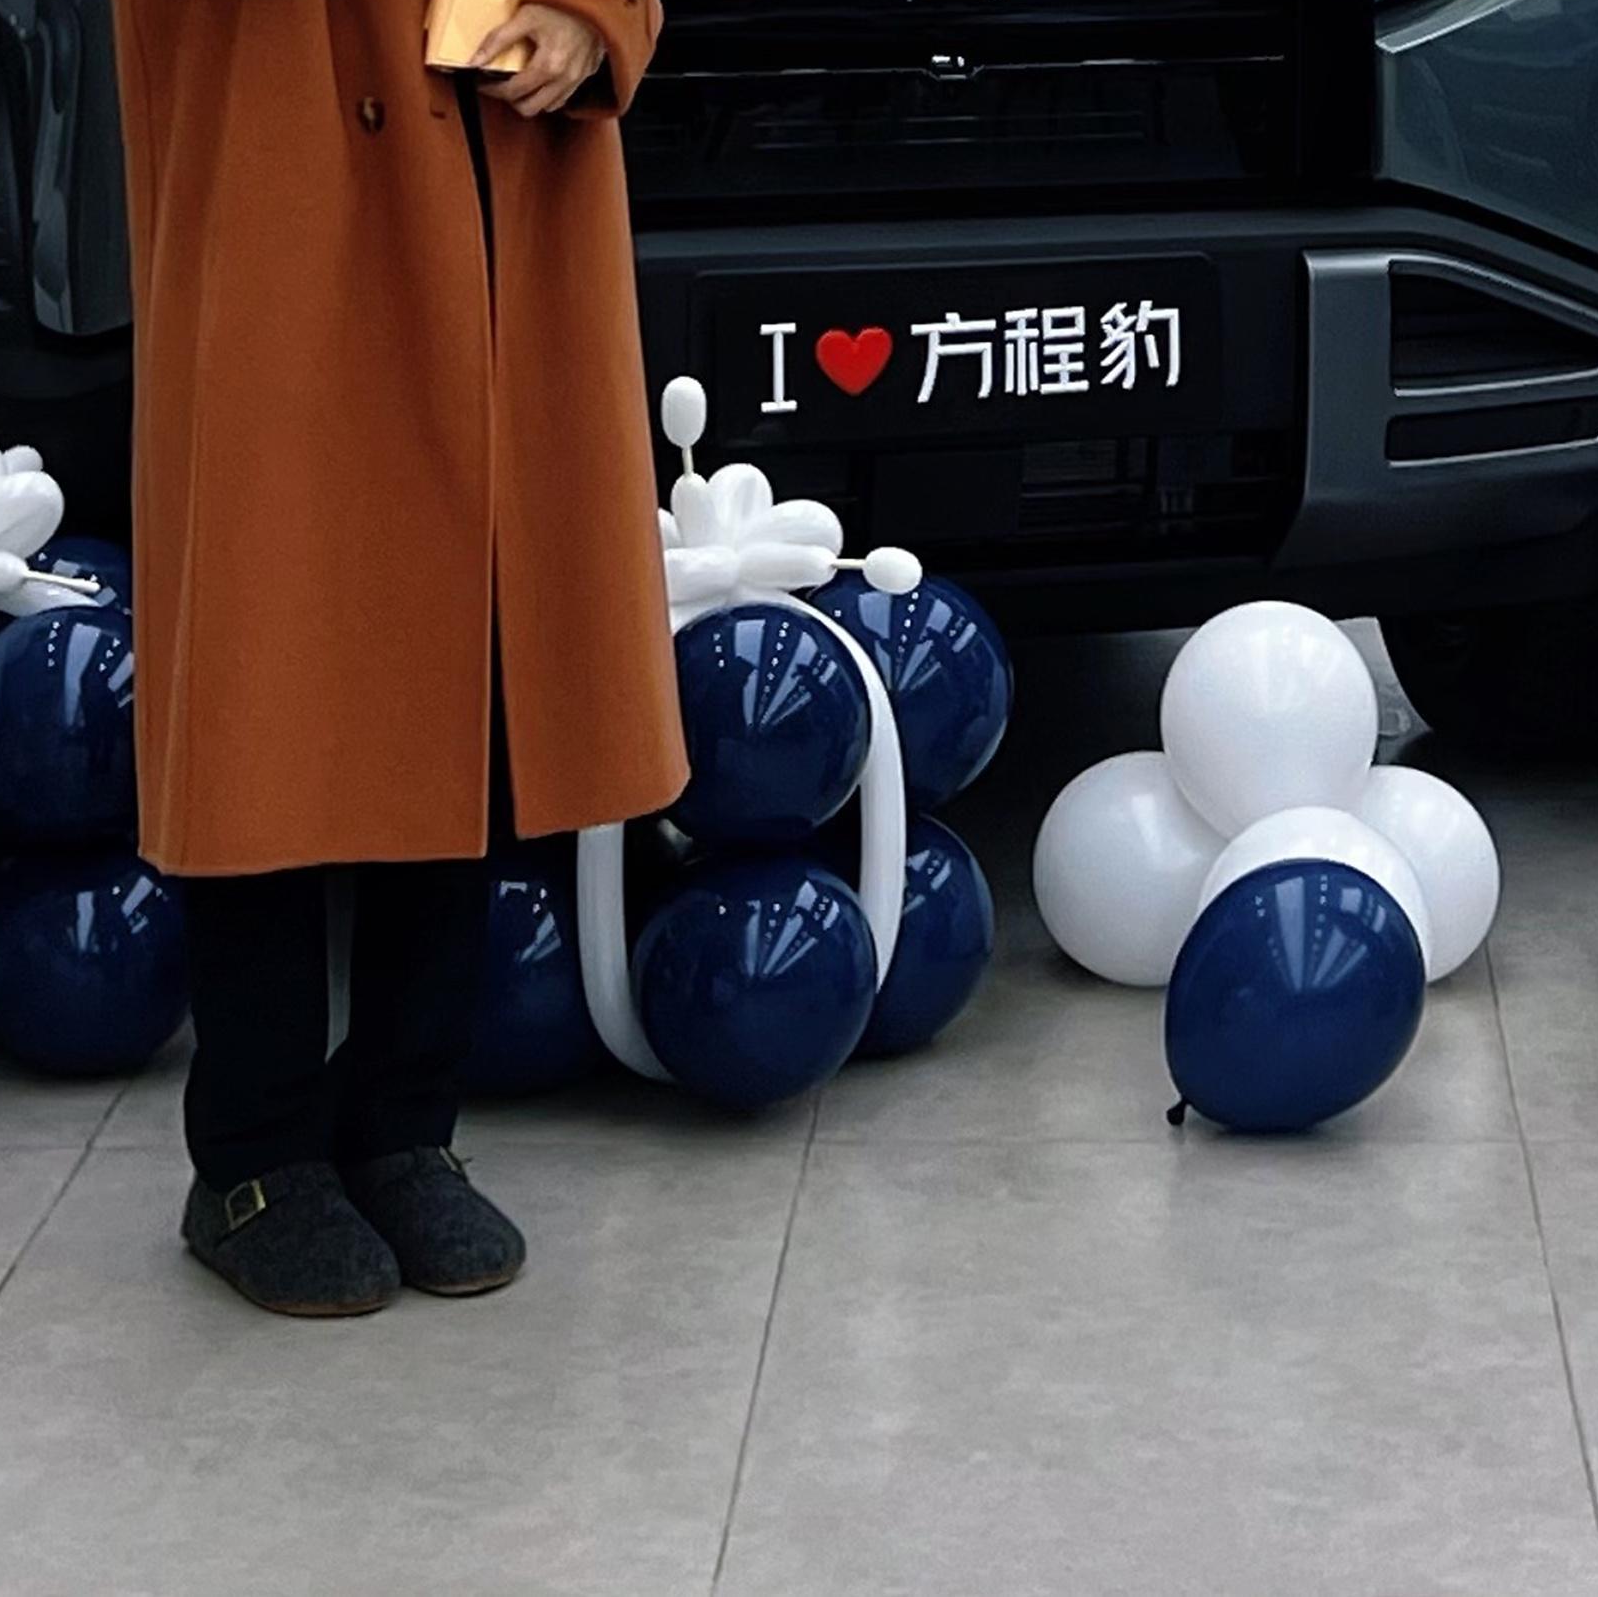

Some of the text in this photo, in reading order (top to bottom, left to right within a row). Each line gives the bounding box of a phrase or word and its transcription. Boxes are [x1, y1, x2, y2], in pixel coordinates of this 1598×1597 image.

[759, 299, 1181, 413] I 方程豹
